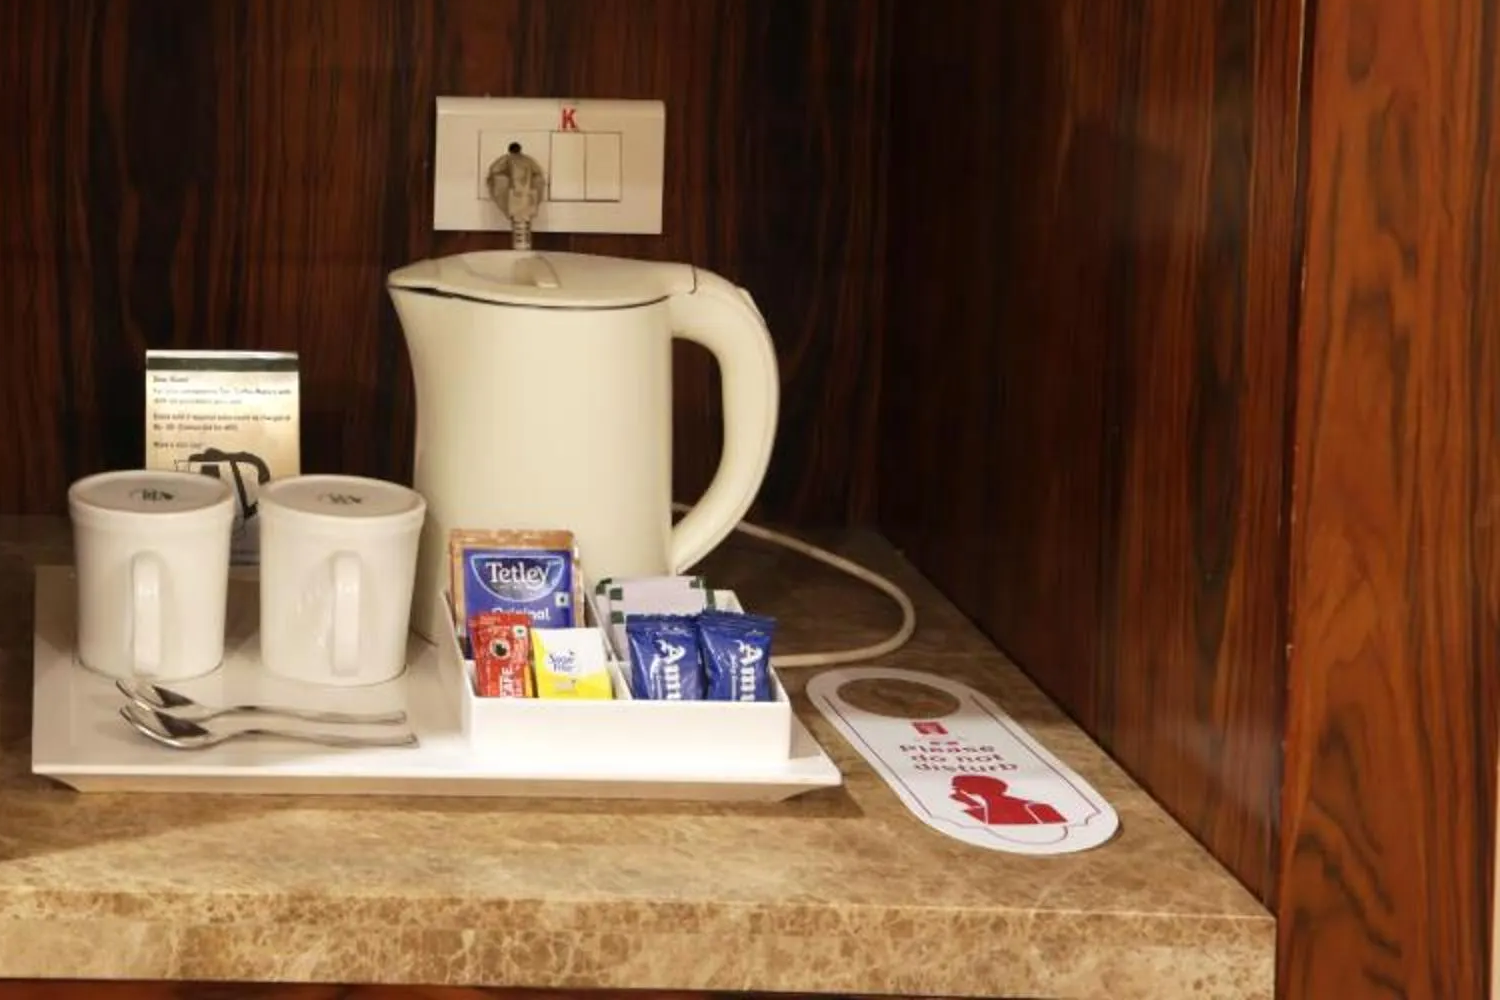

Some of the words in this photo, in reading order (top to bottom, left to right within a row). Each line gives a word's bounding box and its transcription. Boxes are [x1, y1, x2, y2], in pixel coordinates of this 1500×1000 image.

[562, 109, 577, 129] K
[485, 561, 551, 591] Tetley
[899, 744, 995, 753] Please
[911, 753, 947, 762] do
[956, 753, 1004, 762] not
[914, 763, 1018, 773] disturb
